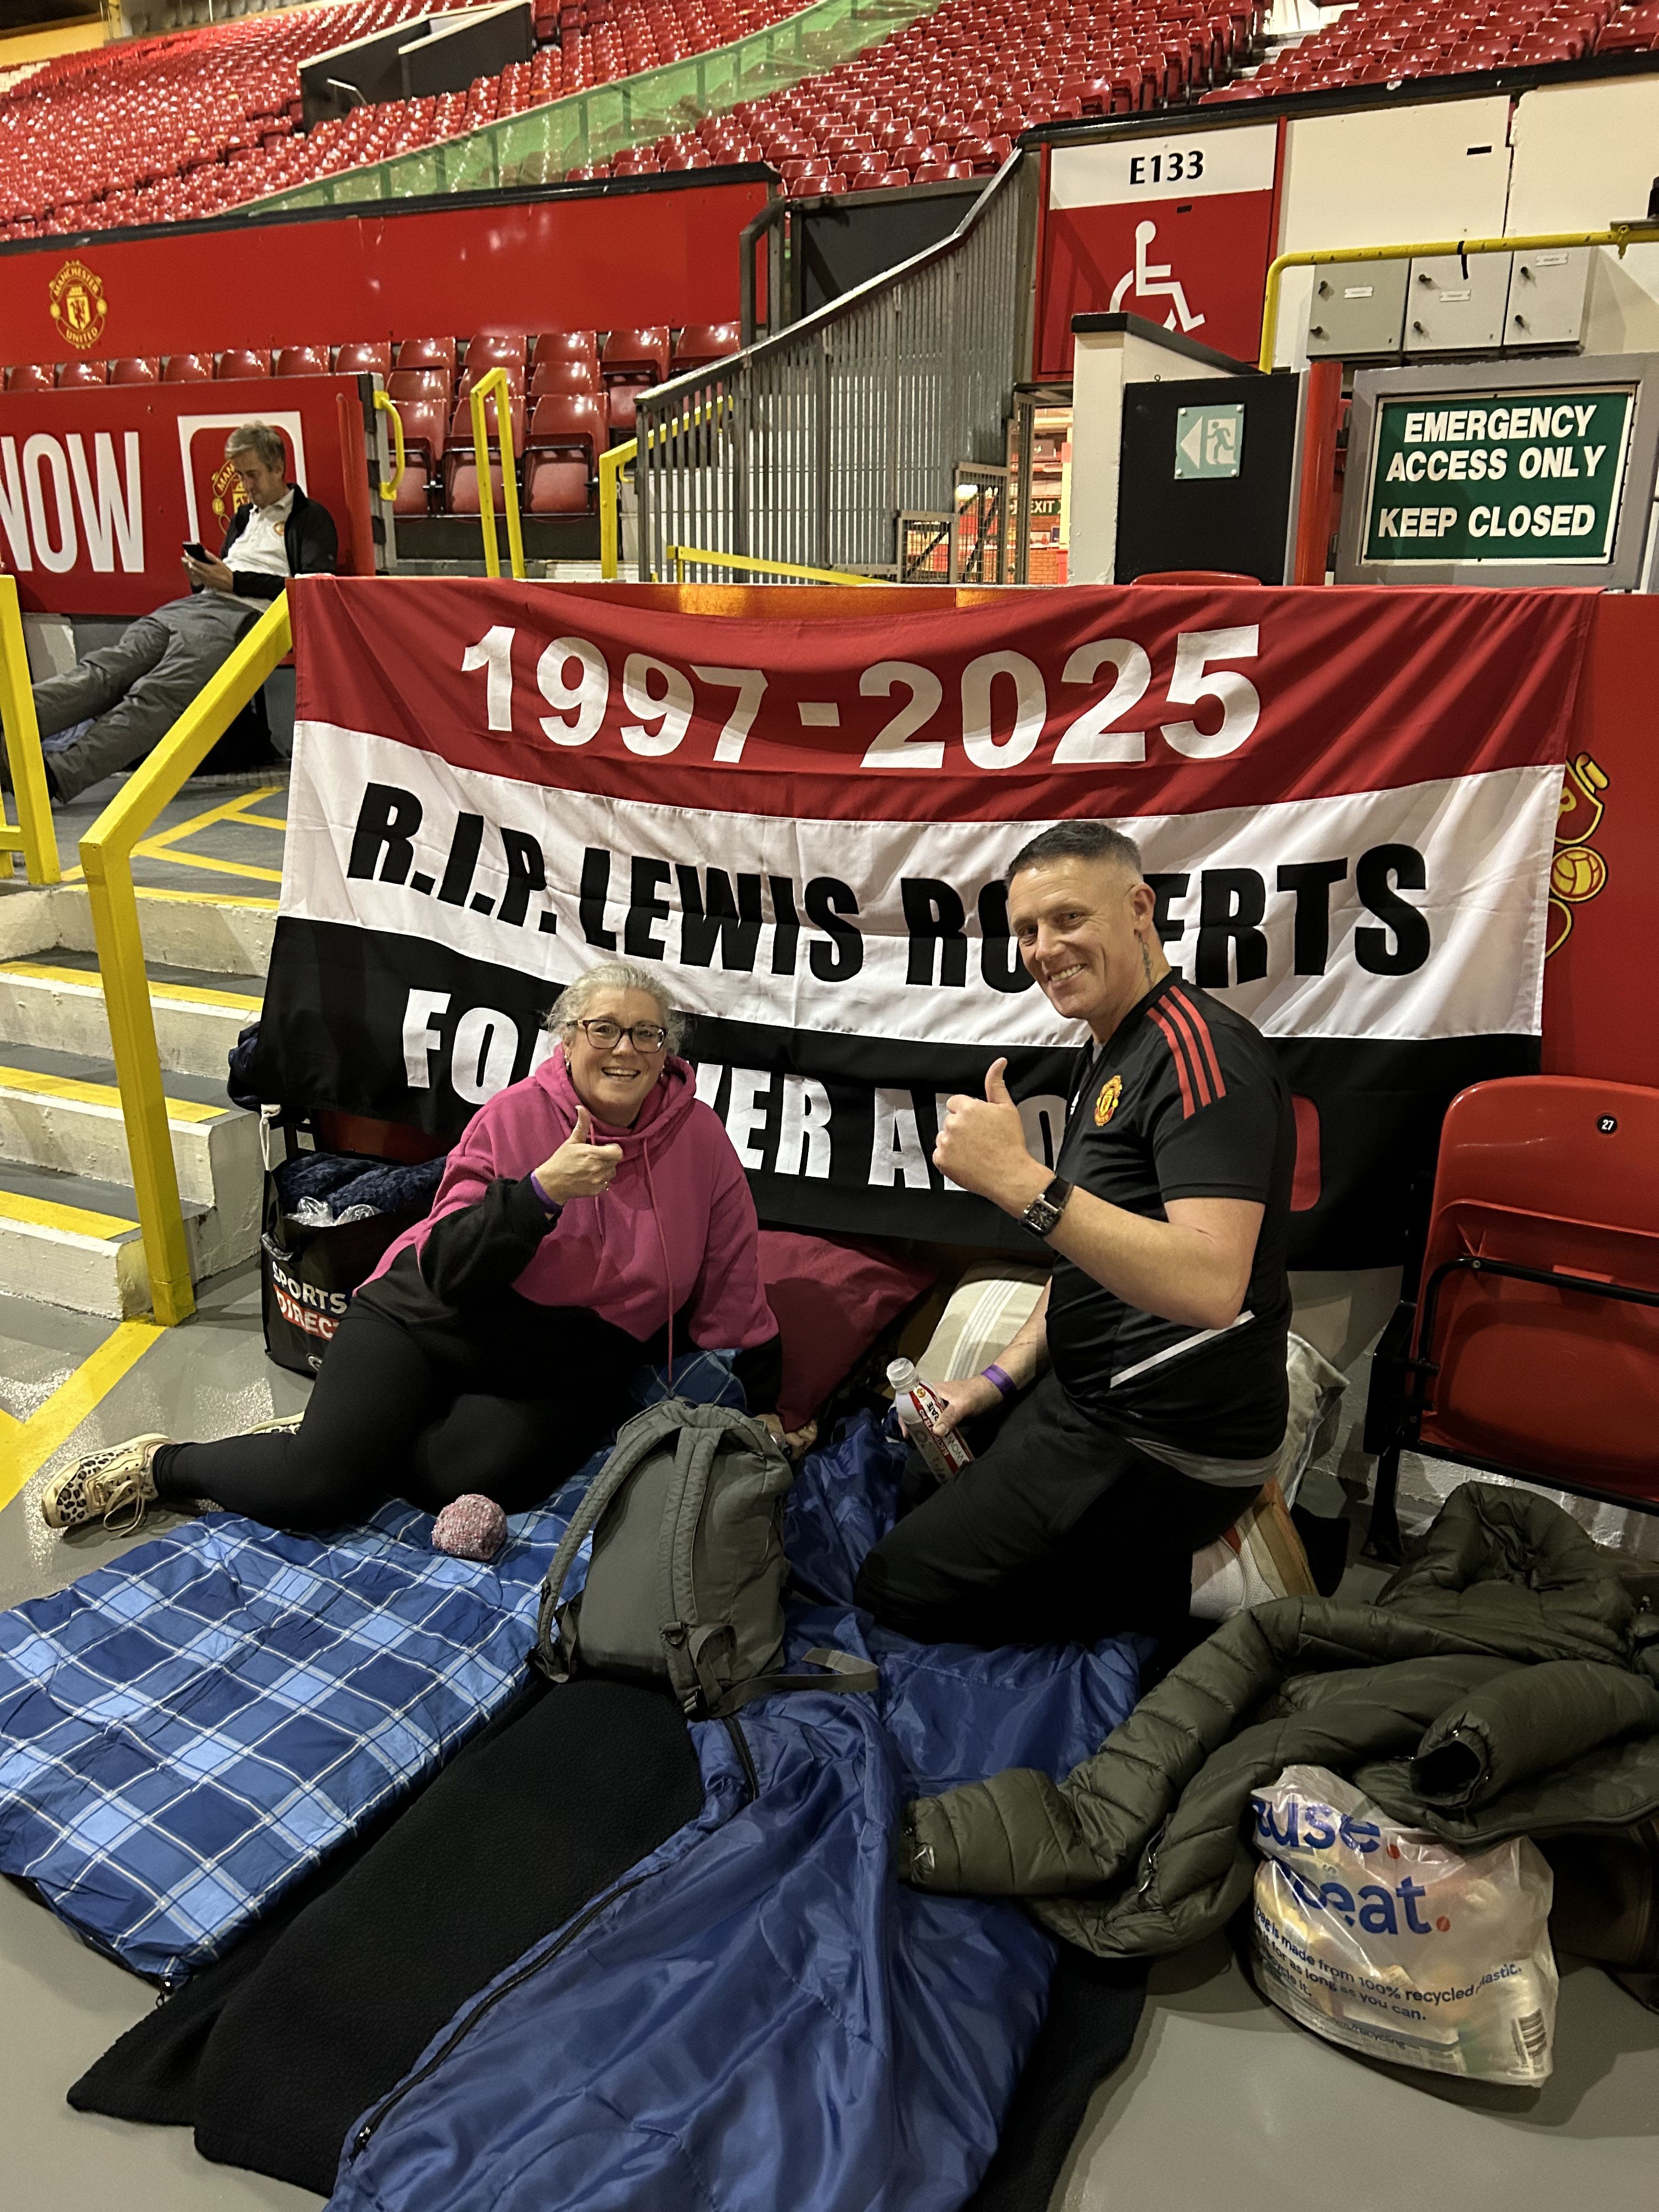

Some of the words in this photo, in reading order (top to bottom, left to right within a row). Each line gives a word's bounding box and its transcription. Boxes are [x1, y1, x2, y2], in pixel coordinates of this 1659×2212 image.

[1129, 150, 1205, 185] E133
[65, 326, 98, 344] UNITED
[1403, 404, 1598, 443] EMERGENCY
[1385, 448, 1508, 482] ACCESS
[1518, 445, 1607, 479] ONLY
[1377, 507, 1458, 538] KEEP
[1468, 504, 1596, 538] CLOSED
[347, 782, 557, 935] R.I.P.
[579, 847, 864, 983] LEWIS
[900, 843, 1431, 994] ROERTS
[402, 989, 832, 1180] FOER
[1601, 1119, 1614, 1131] 27
[272, 1261, 347, 1314] SPORTS
[1256, 1903, 1271, 1932] bag
[1272, 1922, 1279, 1939] is
[1281, 1935, 1316, 1966] made
[1318, 1959, 1355, 1983] from
[1358, 1977, 1401, 2000] 100%
[1405, 1985, 1475, 2006] recycled
[1271, 1940, 1287, 1961] for
[1289, 1959, 1303, 1975] as
[1305, 1968, 1338, 1993] long
[1359, 1993, 1388, 2010] you
[1391, 2005, 1427, 2021] can.
